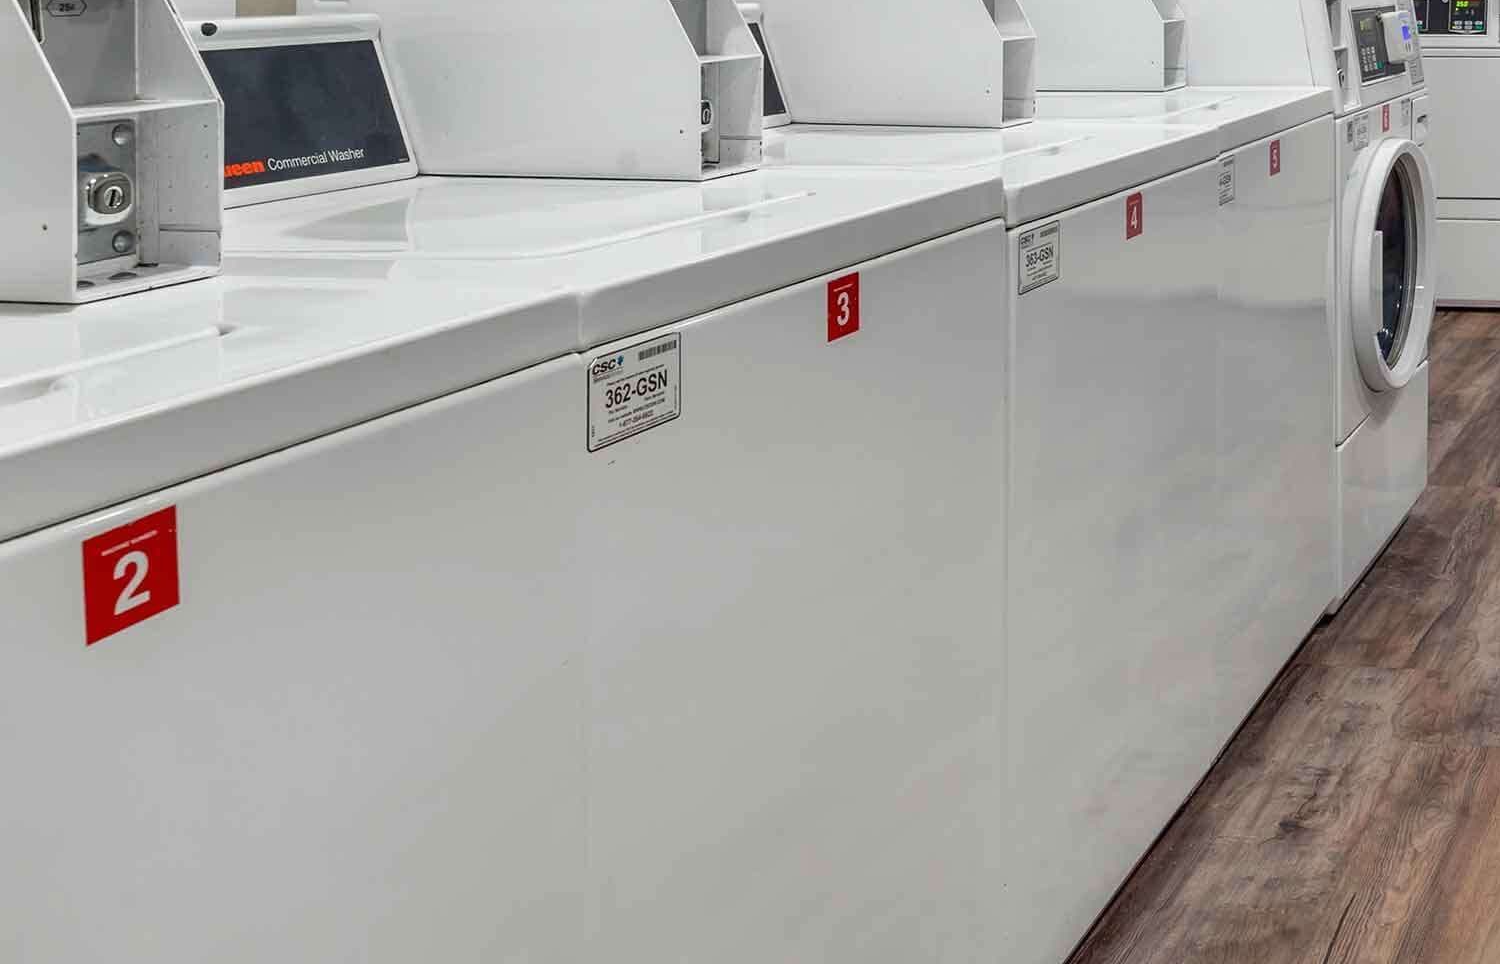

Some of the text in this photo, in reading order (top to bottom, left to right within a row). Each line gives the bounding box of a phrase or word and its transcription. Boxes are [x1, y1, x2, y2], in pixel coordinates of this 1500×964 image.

[223, 147, 366, 178] ueen Commercial Washer
[1130, 205, 1138, 229] 4
[836, 291, 850, 326] 3
[592, 358, 616, 376] CSC
[605, 369, 668, 409] 362-GSN
[113, 549, 151, 616] 2
